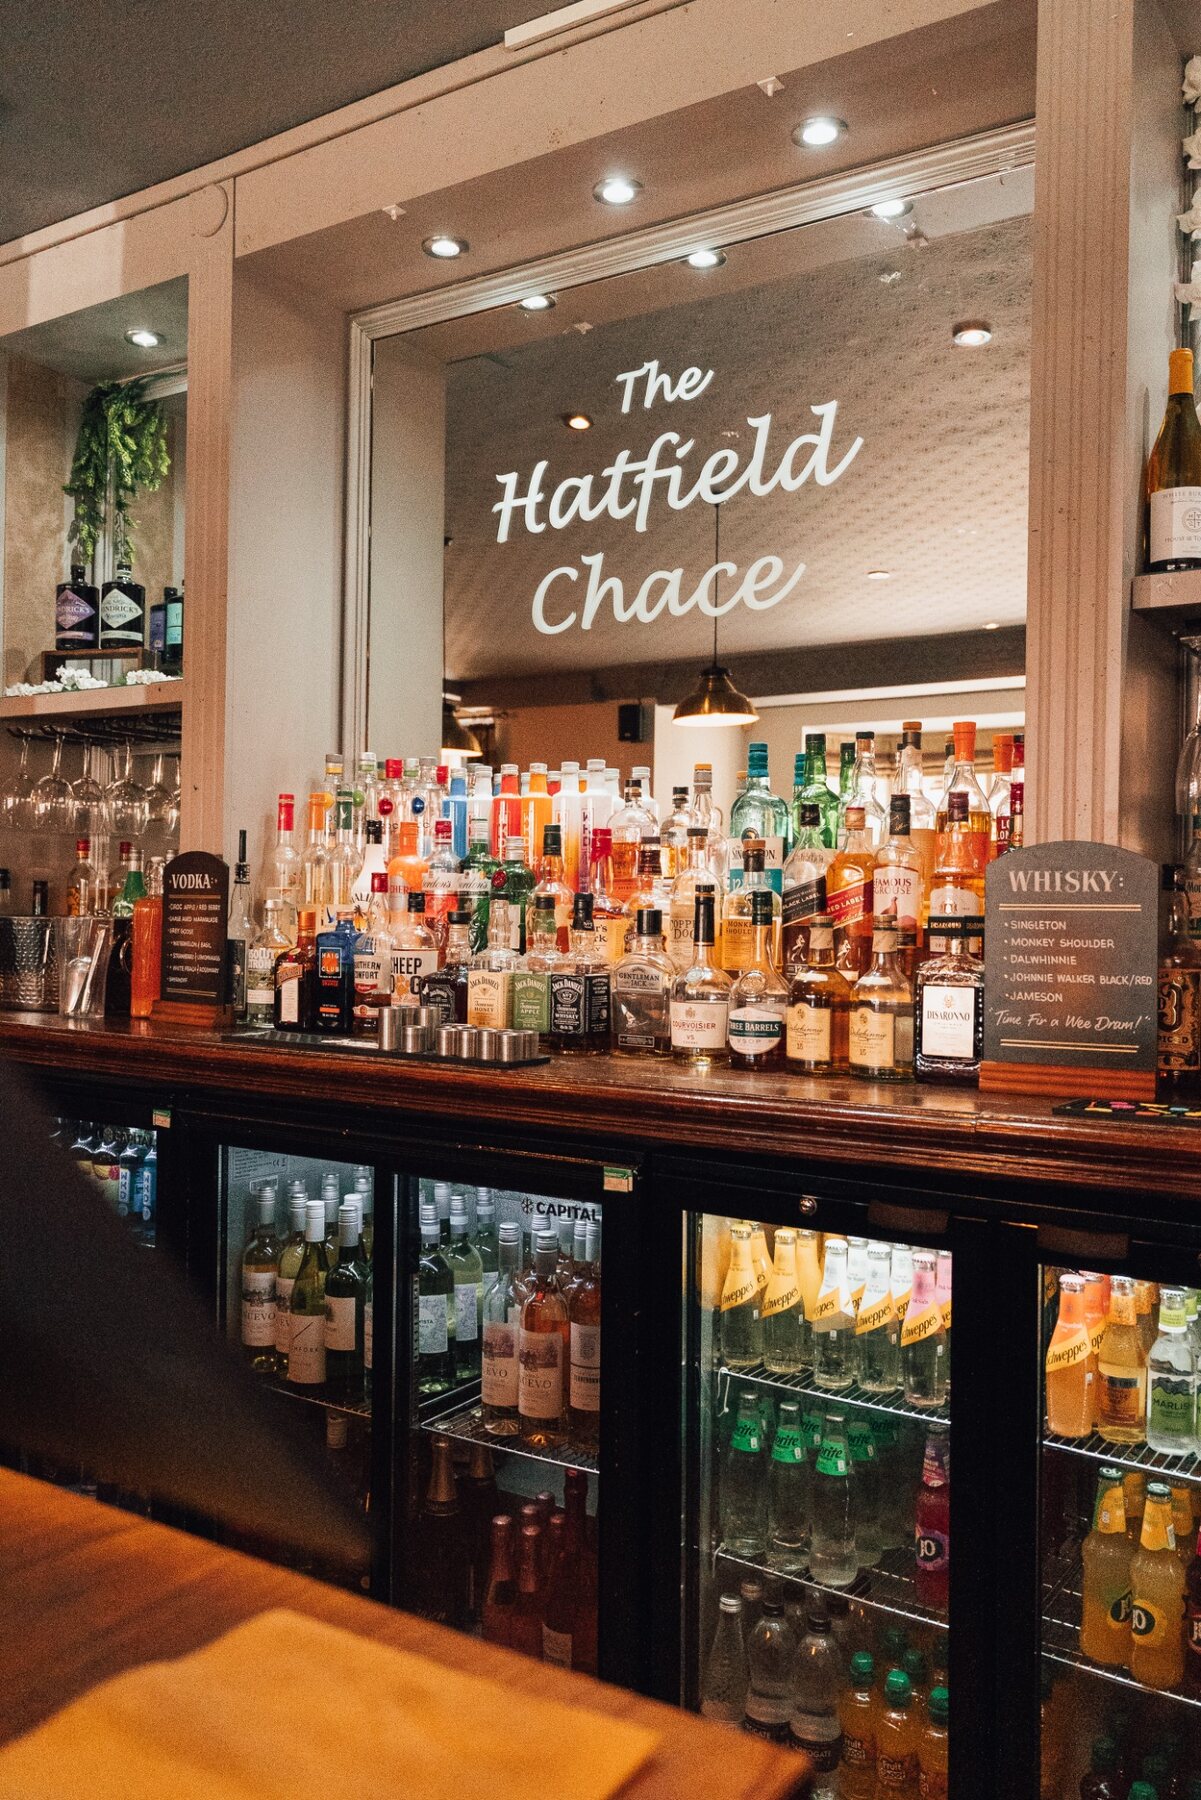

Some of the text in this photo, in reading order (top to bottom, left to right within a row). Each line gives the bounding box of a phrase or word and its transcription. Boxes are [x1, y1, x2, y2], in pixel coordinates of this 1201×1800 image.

[616, 359, 714, 414] The
[492, 400, 864, 544] Hatfield
[531, 552, 807, 635] Chace
[422, 880, 452, 889] ordon's
[457, 880, 488, 890] ordon's
[1008, 870, 1124, 893] WHISKY:
[801, 892, 821, 903] LABEL
[840, 895, 864, 908] LABEL
[727, 920, 752, 928] MONKE
[1010, 920, 1067, 930] SINGLETON
[1010, 938, 1115, 949] MONKEY SHOULDER
[248, 948, 275, 960] SOLUT
[1010, 954, 1077, 965] DALWHINNIE
[355, 960, 381, 970] UTHERN
[355, 970, 379, 979] OMFORT
[618, 972, 660, 981] GENTLEMAN
[1010, 973, 1153, 986] JOHNNIE WALKER BLACK/RED
[470, 978, 481, 990] JACK
[514, 980, 527, 991] JACK
[1010, 992, 1063, 1002] JAMESON
[926, 1010, 970, 1021] DISARONNO
[672, 1020, 717, 1030] COURVOISIER
[744, 1022, 779, 1032] BARRELS
[1065, 1016, 1091, 1029] Wee
[536, 1201, 600, 1222] CAPITAL
[762, 1287, 799, 1311] chweppes
[247, 1312, 276, 1321] UEVO
[902, 1314, 938, 1338] chweppes
[1047, 1340, 1088, 1365] chweppes
[486, 1366, 508, 1378] EVO
[775, 1434, 800, 1448] prite
